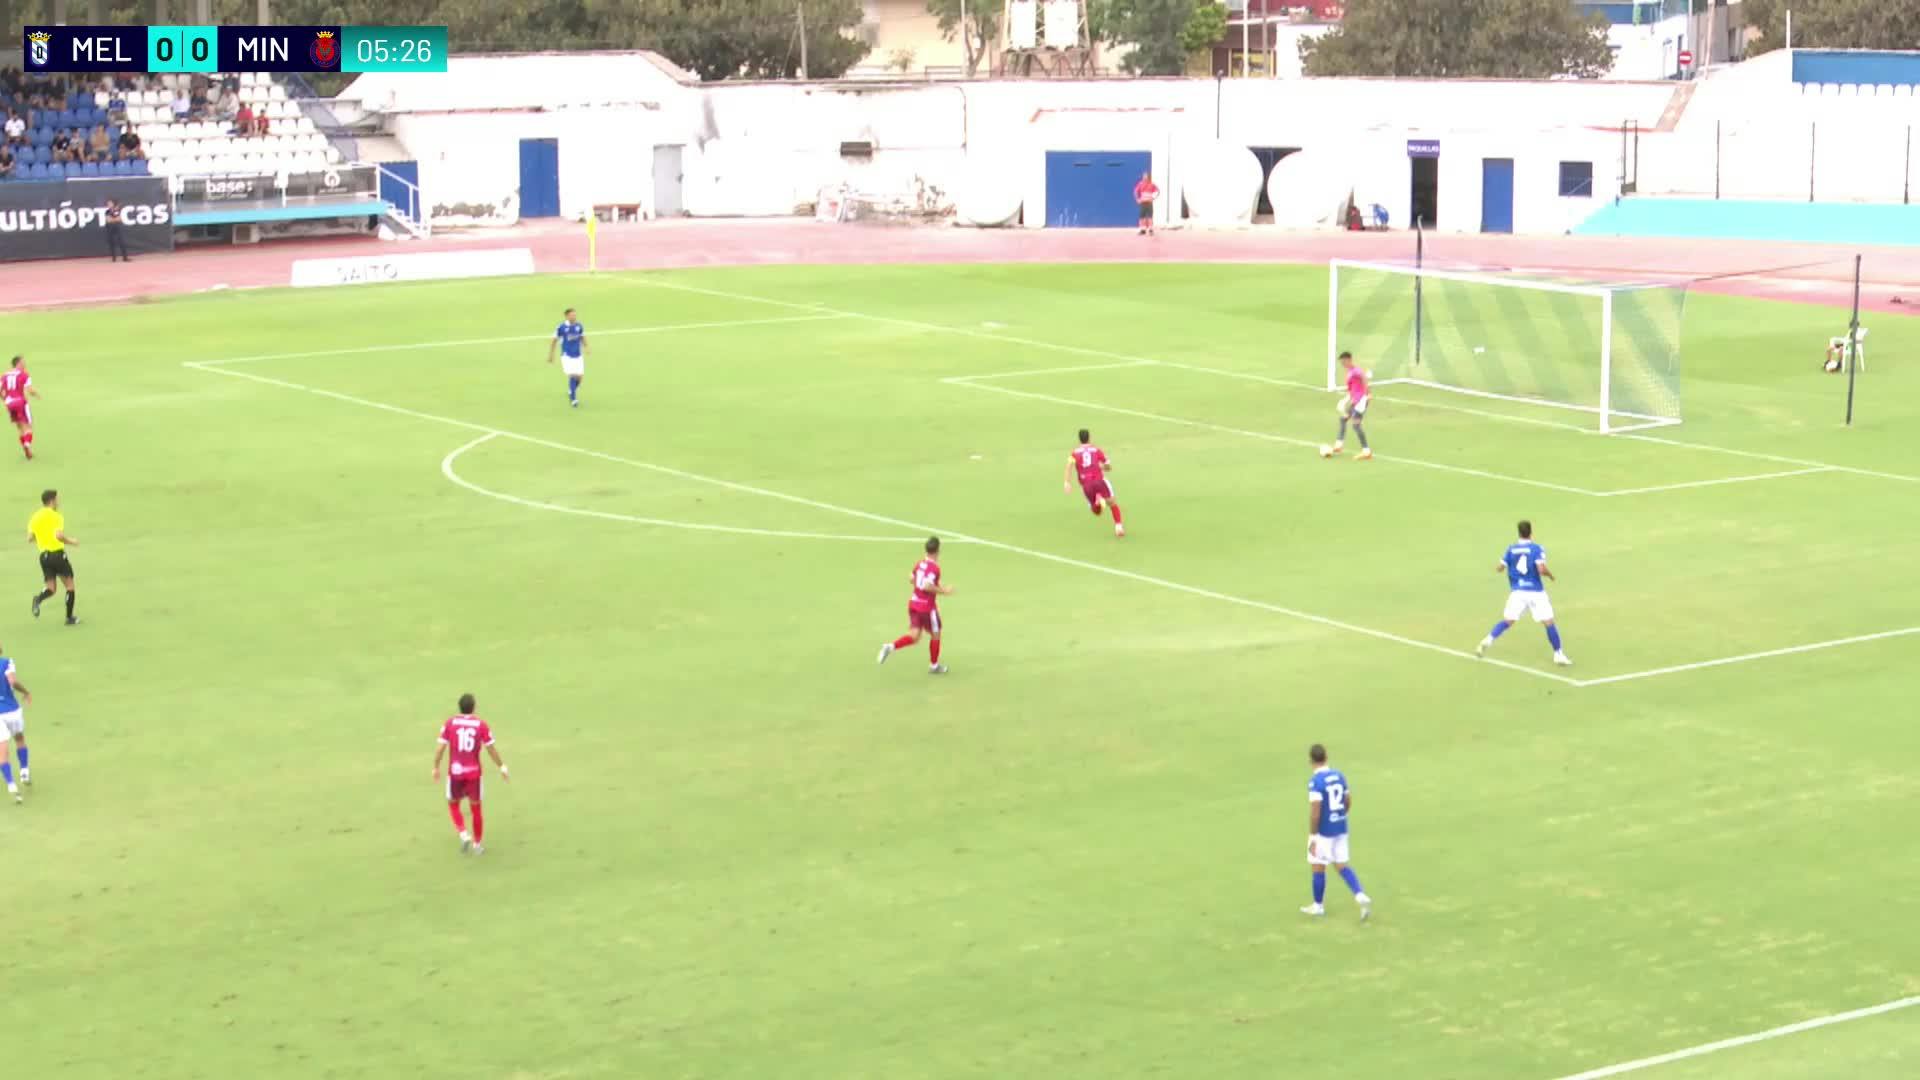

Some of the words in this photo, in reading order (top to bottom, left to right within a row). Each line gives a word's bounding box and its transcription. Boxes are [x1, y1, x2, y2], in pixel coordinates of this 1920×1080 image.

[1516, 554, 1528, 575] 4
[456, 727, 476, 752] 16
[1326, 783, 1345, 811] 12
